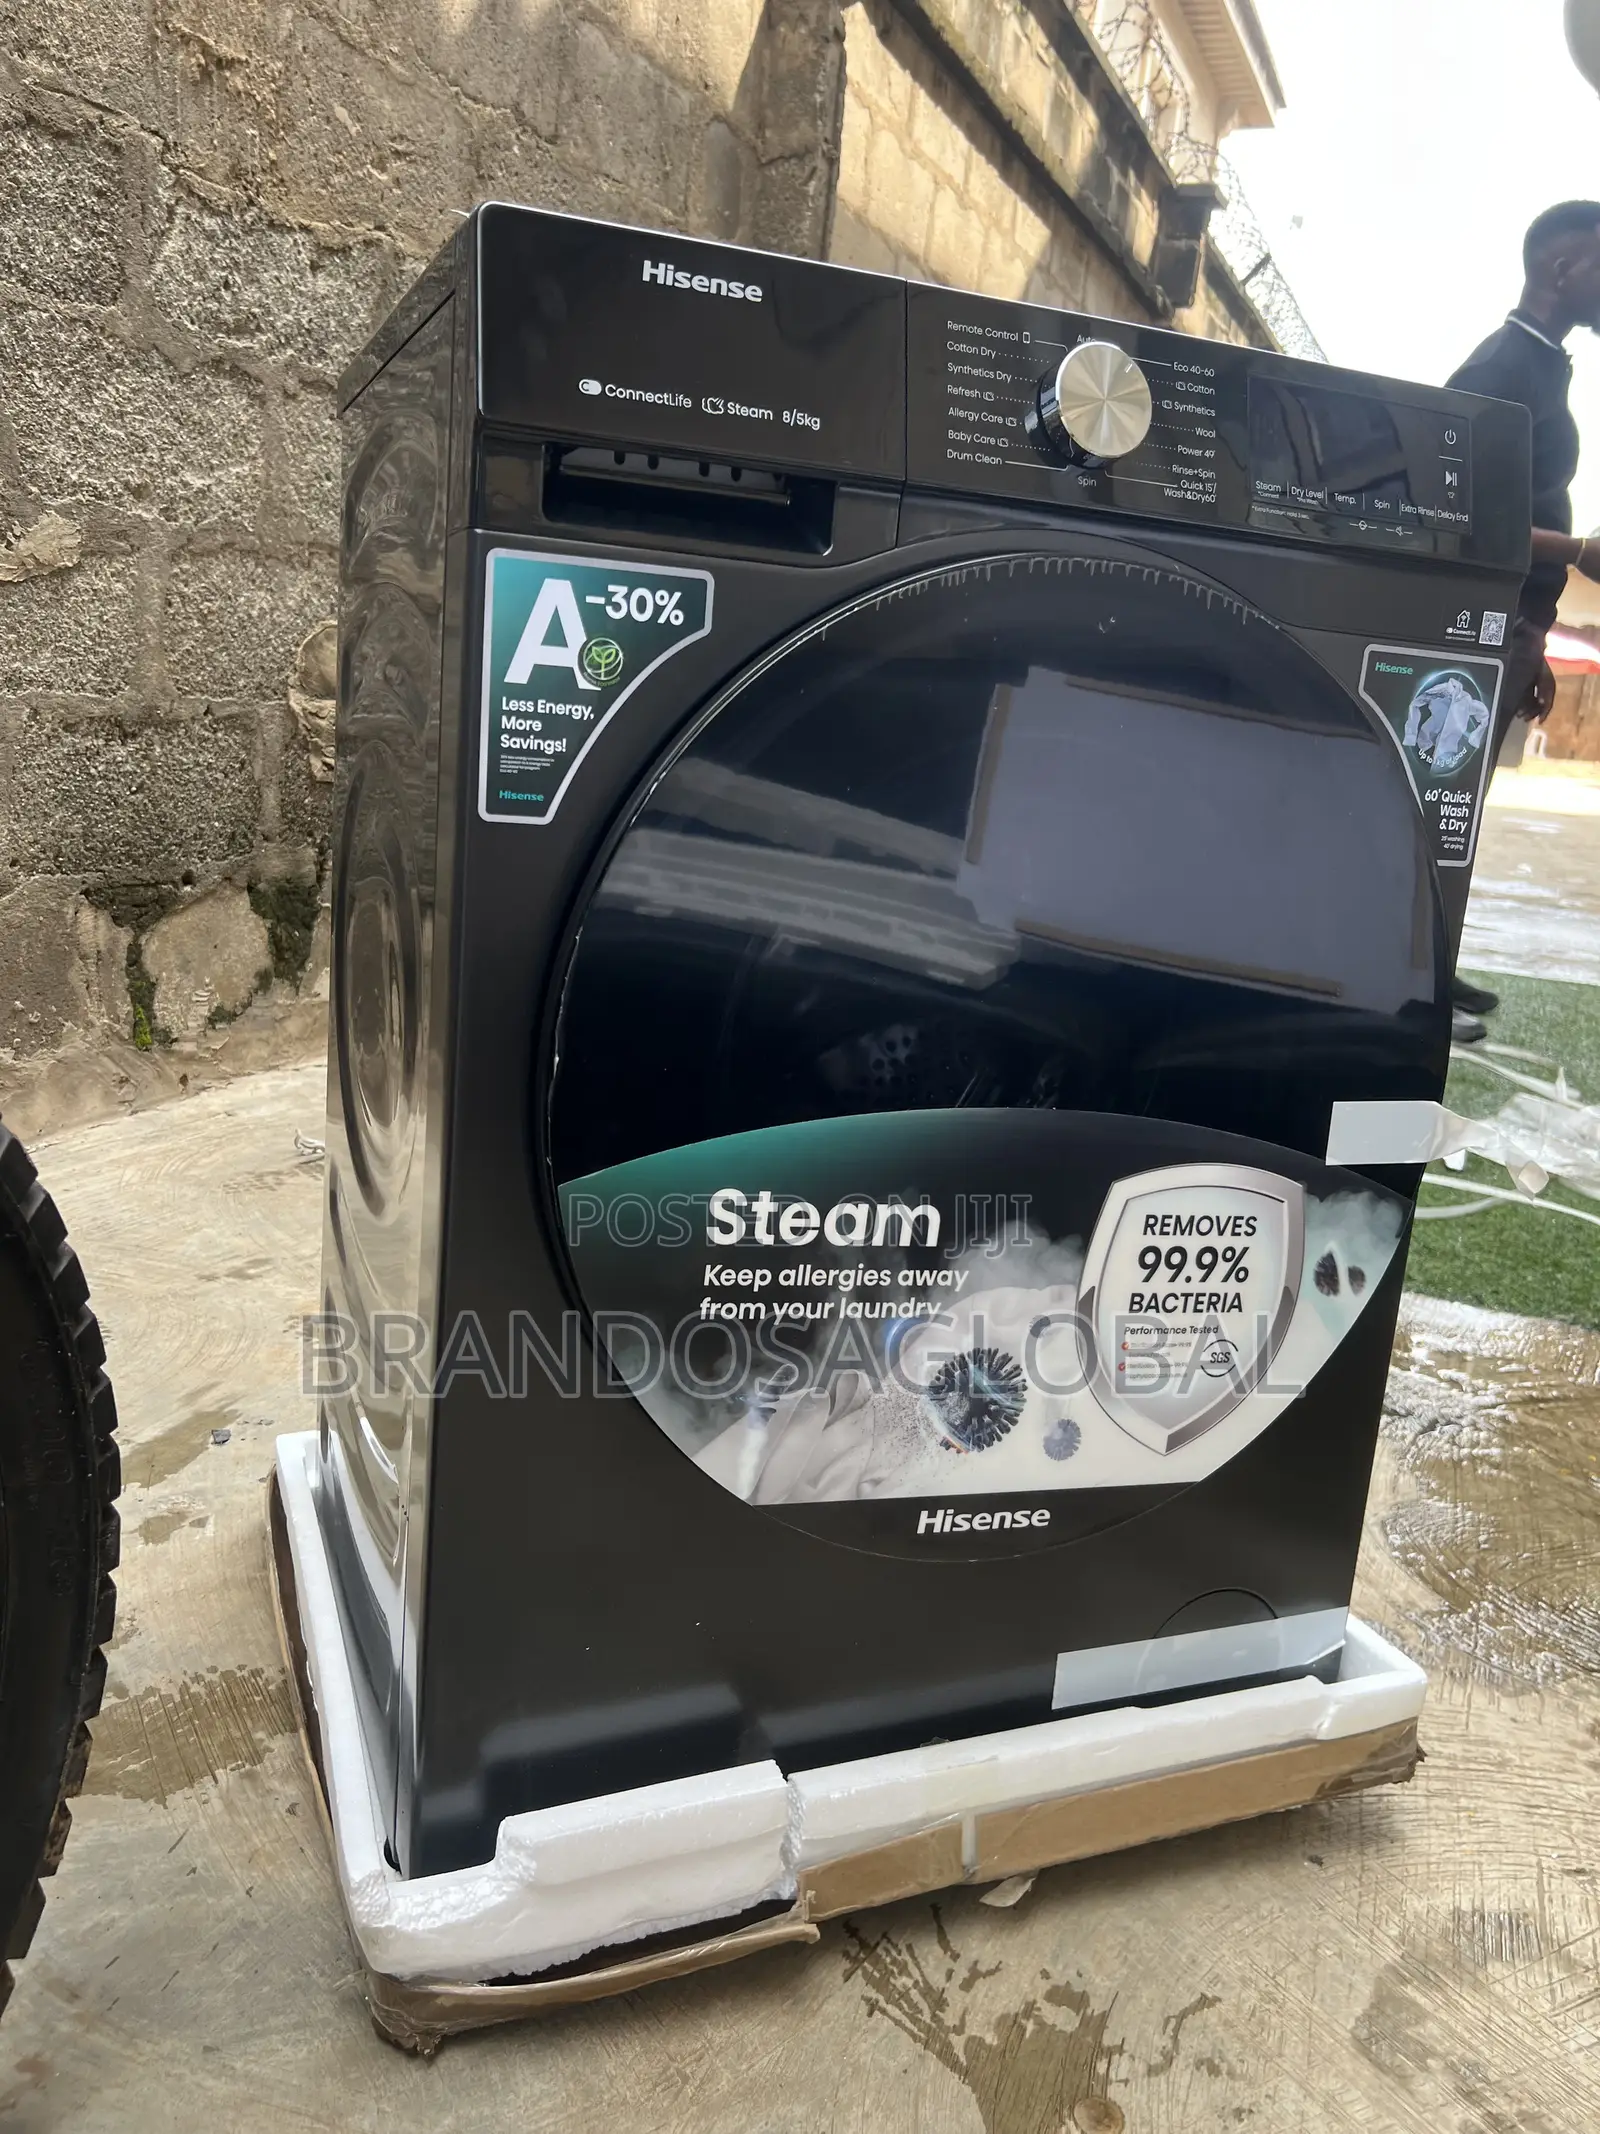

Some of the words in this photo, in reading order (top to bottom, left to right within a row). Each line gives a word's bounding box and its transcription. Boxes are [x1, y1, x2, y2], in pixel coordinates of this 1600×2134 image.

[641, 259, 763, 302] Hisense
[947, 321, 983, 336] Remote
[985, 328, 1019, 341] Control
[947, 341, 978, 354] Cotton
[981, 347, 996, 359] Dry
[947, 363, 995, 379] Synthetics
[996, 371, 1012, 383] Dry
[1173, 362, 1188, 373] Eco
[1190, 365, 1215, 377] 40-60
[947, 385, 981, 399] Refresh
[1187, 383, 1215, 395] Cotton
[605, 384, 692, 409] ConnectLife
[727, 402, 773, 420] Steam
[782, 409, 820, 431] 8/5kg
[948, 407, 979, 423] Allergy
[981, 412, 1003, 424] Care
[1174, 402, 1216, 417] Synthetics
[948, 430, 971, 443] Baby
[973, 433, 995, 445] Care
[1195, 427, 1216, 438] Wool
[946, 449, 973, 461] Drum
[974, 452, 1003, 465] Clean
[1177, 445, 1203, 457] Power
[1172, 464, 1216, 480] Rinse+Spin
[1077, 475, 1097, 487] Spin
[1180, 479, 1204, 491] Quick
[1255, 480, 1281, 492] Steam
[1291, 486, 1304, 498] Dry
[1305, 489, 1324, 499] Level
[1334, 493, 1357, 505] Temp.
[1374, 500, 1391, 510] Spin
[1401, 504, 1417, 514] Extra
[1418, 506, 1435, 517] Rinse
[1437, 510, 1456, 522] Delay
[1456, 512, 1469, 523] End
[504, 578, 601, 691] A
[585, 584, 684, 626] -30%
[1375, 662, 1414, 675] Hisense
[502, 696, 535, 713] Less
[537, 699, 595, 720] Energy,
[501, 715, 542, 732] More
[500, 734, 567, 755] Savings!
[1418, 749, 1427, 760] Up
[1426, 755, 1433, 764] to
[1452, 746, 1467, 761] load
[499, 790, 545, 802] Hisense
[1441, 790, 1473, 804] Quick
[1440, 804, 1469, 817] Wash
[1449, 843, 1464, 851] drying
[706, 1187, 942, 1248] Steam
[1142, 1214, 1258, 1237] REMOVES
[1138, 1245, 1250, 1283] 99.9%
[703, 1264, 772, 1292] Keep
[778, 1263, 892, 1292] allergies
[897, 1268, 969, 1292] away
[699, 1296, 767, 1321] from
[771, 1300, 834, 1326] your
[838, 1296, 942, 1323] laundry
[1128, 1292, 1243, 1314] BACTERIA
[1124, 1326, 1187, 1336] Performance
[1189, 1324, 1220, 1335] Tested
[1210, 1351, 1231, 1363] SGS
[916, 1508, 1051, 1534] Hisense
